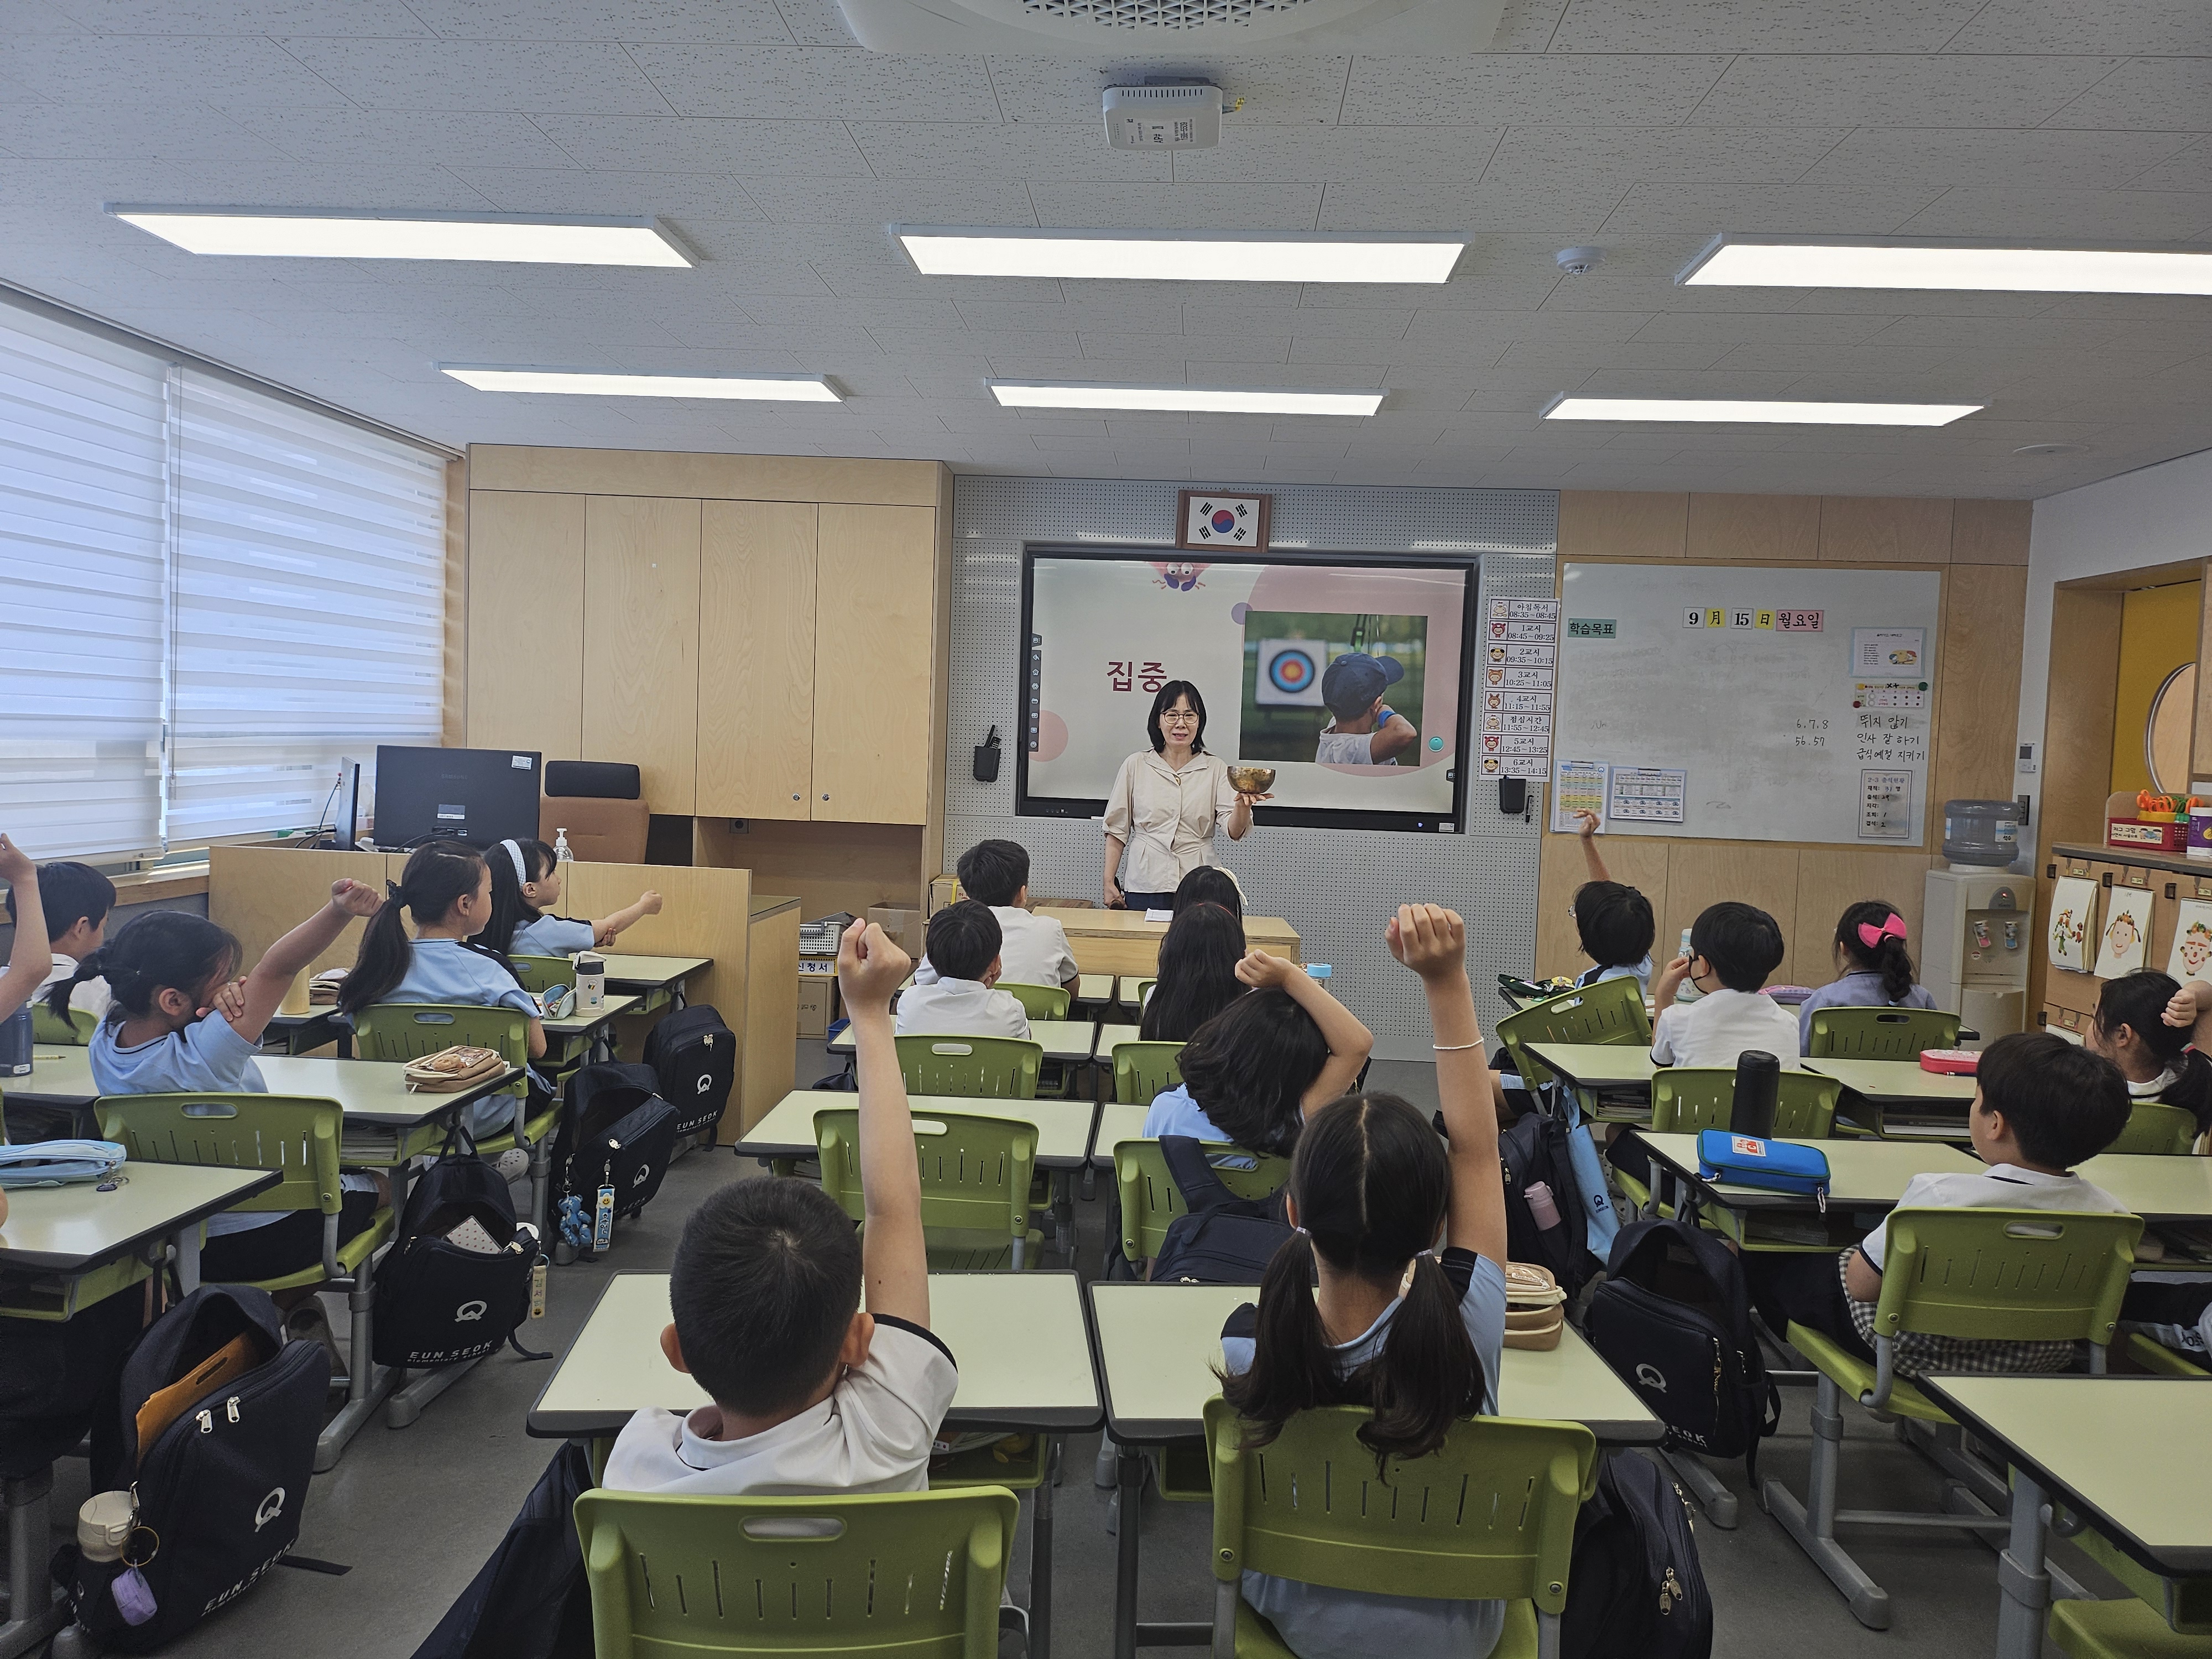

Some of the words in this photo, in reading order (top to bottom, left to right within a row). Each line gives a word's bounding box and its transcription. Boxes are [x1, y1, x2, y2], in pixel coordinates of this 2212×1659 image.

[1517, 604, 1548, 612] 아침독서
[1689, 612, 1698, 625] 9
[1710, 611, 1721, 625] 月
[1735, 613, 1749, 625] 15
[1760, 614, 1770, 625] 日
[1778, 612, 1819, 628] 월요일
[1570, 622, 1614, 635] 학습목표
[1520, 648, 1540, 656] 2교시
[1107, 661, 1167, 692] 집중
[1518, 671, 1538, 679] 3교시
[1510, 716, 1542, 724] 점심시간
[1860, 714, 1881, 728] 뛰지
[1514, 737, 1535, 745] 5교시
[1857, 732, 1877, 744] 인사
[1856, 748, 1892, 760] 급식예절
[1897, 750, 1924, 762] 지키기
[1513, 758, 1533, 766] 6교시
[799, 963, 827, 972] 신청서
[677, 1120, 695, 1130] EUN
[697, 1110, 718, 1124] SEOK
[410, 1351, 444, 1359] EUN
[451, 1340, 493, 1357] SEOK
[1666, 1425, 1706, 1444] EOK
[204, 1579, 244, 1611] EUN
